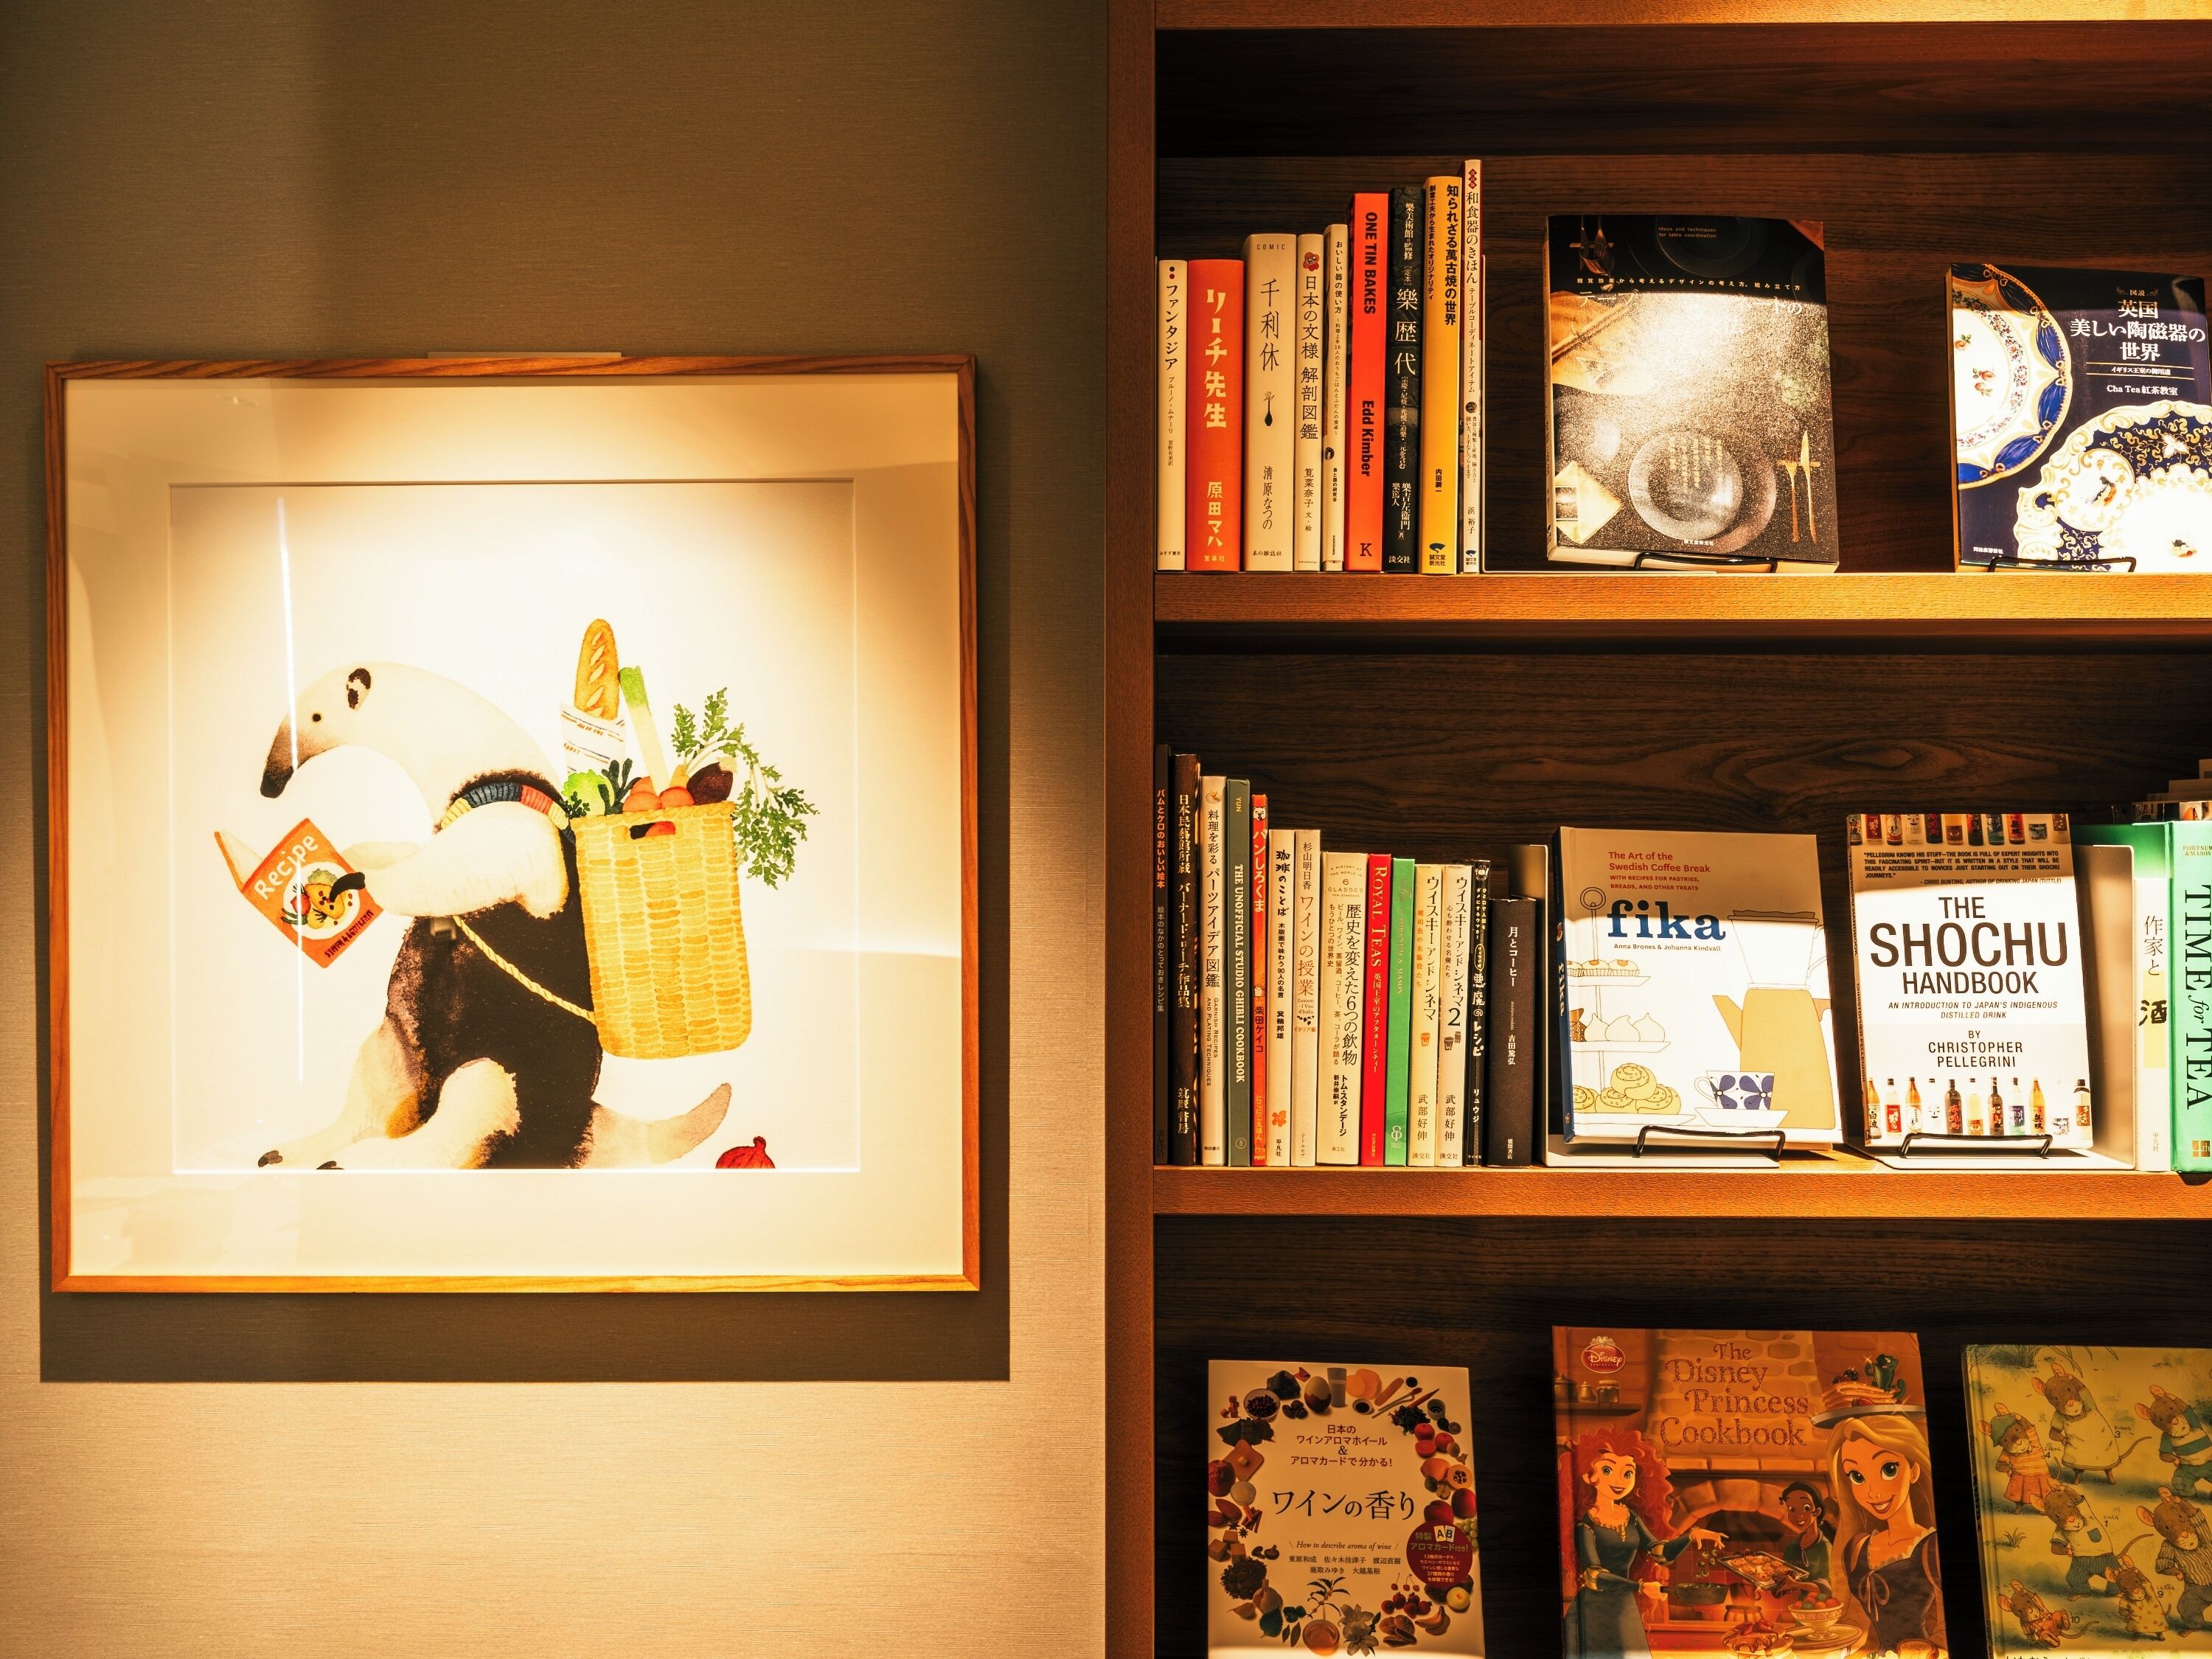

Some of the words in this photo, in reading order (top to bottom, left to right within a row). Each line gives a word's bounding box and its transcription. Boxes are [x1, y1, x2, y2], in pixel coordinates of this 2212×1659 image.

[1366, 212, 1377, 240] ONE
[1466, 191, 1479, 284] 和食器のきほん
[1365, 243, 1377, 265] TIN
[1444, 184, 1459, 326] 知られざる萬古焼の世界
[1334, 240, 1343, 314] おいしい器の使い方
[1364, 269, 1377, 315] BAKES
[1165, 283, 1179, 371] ファンタジア
[1259, 278, 1280, 372] 千利休
[1301, 275, 1320, 360] 日本の文様
[2118, 299, 2159, 319] 英国
[2070, 318, 2206, 342] 美しい陶磁器の
[1203, 289, 1228, 428] リーチ先生
[2119, 341, 2161, 362] 世界
[1300, 366, 1319, 440] 解剖図鑑
[2107, 384, 2123, 393] Cha
[2125, 385, 2140, 394] Tea
[2141, 386, 2179, 396] 紅茶教室
[1362, 400, 1374, 425] Edd
[1361, 428, 1374, 477] Kimber
[1207, 481, 1223, 548] 原田マハ
[1262, 465, 1273, 530] 清原なつの
[1360, 543, 1372, 557] K
[1388, 555, 1411, 563] 淡交社
[253, 835, 319, 900] Recipe
[1234, 864, 1243, 885] THE
[1253, 829, 1268, 913] パンしろくま
[1302, 842, 1312, 890] 杉山明日香
[1608, 852, 1626, 860] The
[1628, 852, 1644, 860] Art
[1646, 852, 1655, 860] of
[1658, 852, 1673, 860] the
[1610, 862, 1649, 871] Swedish
[1651, 863, 1681, 872] Coffee
[1683, 864, 1711, 873] Break
[1372, 866, 1388, 919] ROYAL
[1938, 897, 1986, 919] THE
[1234, 888, 1244, 948] UNOFFICIAL
[1326, 903, 1335, 967] もうひとつの世界史
[1607, 899, 1726, 941] fika
[2185, 884, 2212, 991] TIME
[1277, 922, 1285, 998] 木版画で味わう90人の名言
[1297, 897, 1315, 996] ワインの授業
[1371, 924, 1386, 967] TEAS
[1508, 926, 1519, 988] 月とコーヒー
[1870, 922, 2067, 967] SHOCHU
[2143, 915, 2164, 975] 作家と
[1235, 950, 1244, 987] STUDIO
[1341, 903, 1362, 1066] 歴史を変えた6つの飲物
[1557, 961, 1566, 1015] fika
[1902, 971, 2039, 995] HANDBOOK
[1235, 990, 1245, 1025] GHIBLI
[1472, 973, 1486, 1057] 悪魔のレシピ
[2138, 999, 2168, 1026] 酒
[2188, 995, 2210, 1024] for
[1254, 1005, 1265, 1053] 柴田ケイコ
[1928, 1042, 2023, 1053] CHRISTOPHER
[1968, 1030, 1980, 1039] BY
[1236, 1027, 1245, 1083] COOKBOOK
[1507, 1034, 1516, 1065] 吉田篤弘
[1937, 1056, 2016, 1068] PELLEGRINI
[2185, 1027, 2212, 1110] TEA
[1339, 1075, 1348, 1137] トム・スタンデージ
[1417, 1094, 1428, 1141] 武部好伸
[1444, 1095, 1456, 1141] 武部好伸
[1587, 1350, 1623, 1366] Disney
[1713, 1342, 1753, 1361] The
[1664, 1357, 1769, 1391] Disney
[1684, 1388, 1809, 1414] Princess
[1296, 1435, 1388, 1447] ワインアロマホイール
[1326, 1424, 1357, 1435] 日本の
[1660, 1416, 1807, 1447] Cookbook
[2115, 1430, 2121, 1439] 3
[1338, 1445, 1349, 1456] &
[1272, 1489, 1415, 1520] ワインの香り
[1296, 1540, 1312, 1548] How
[1321, 1541, 1346, 1549] describe
[1368, 1542, 1377, 1551] of
[1377, 1542, 1392, 1550] wine
[2157, 1590, 2164, 1599] 9
[2070, 1615, 2081, 1624] 10
